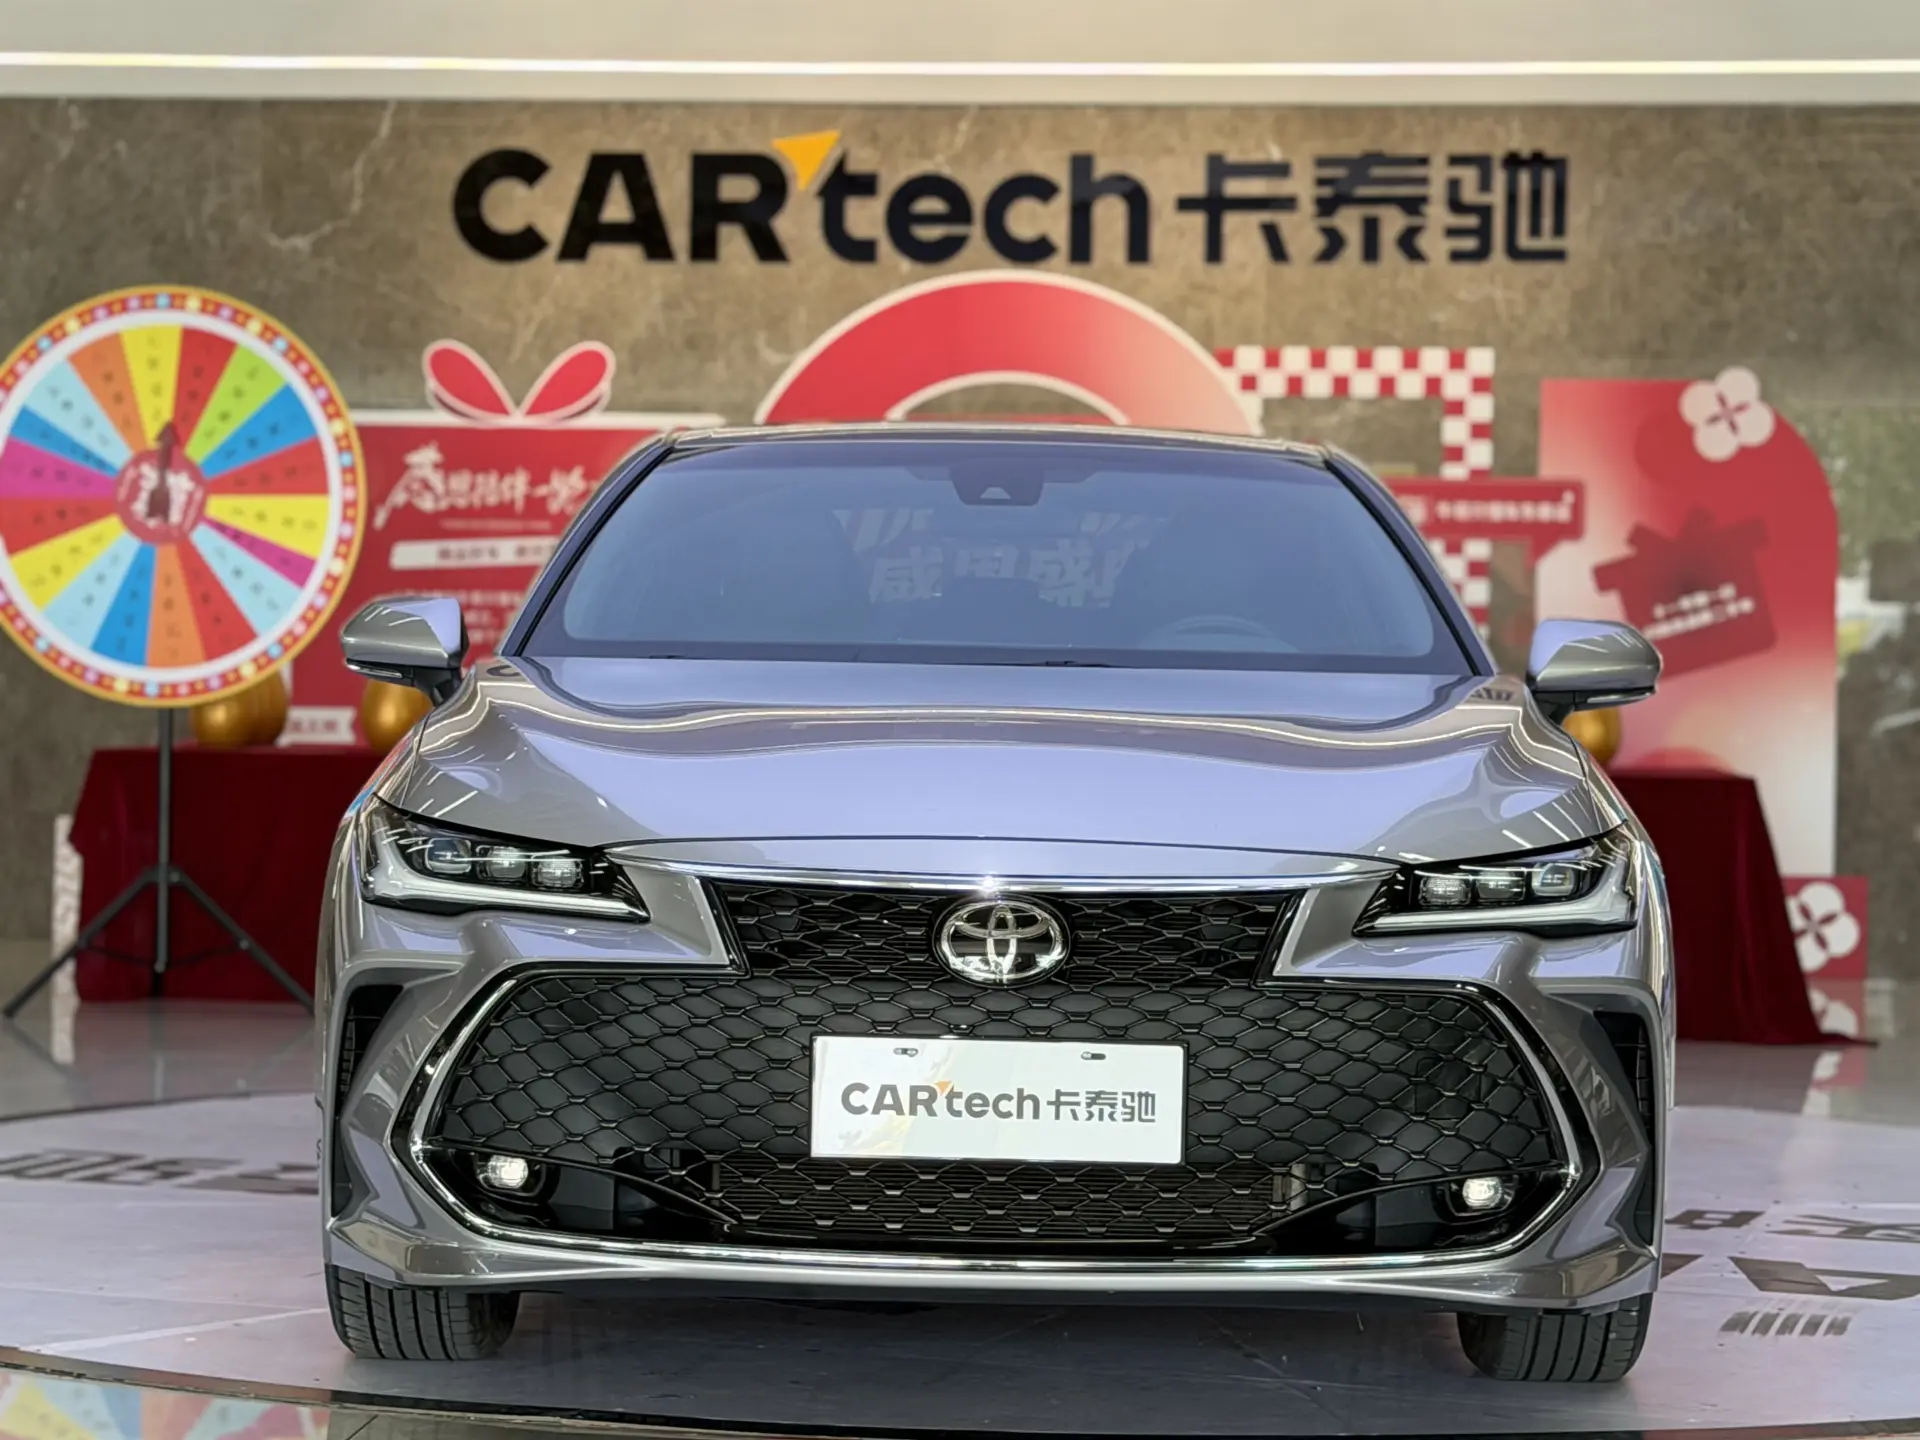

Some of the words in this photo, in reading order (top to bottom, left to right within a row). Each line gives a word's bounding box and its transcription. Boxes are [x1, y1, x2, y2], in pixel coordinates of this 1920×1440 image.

[451, 149, 1151, 264] CARtech
[1177, 151, 1568, 263] 卡泰驰
[841, 1082, 1041, 1121] CARtech
[1046, 1088, 1157, 1124] 卡泰驰
